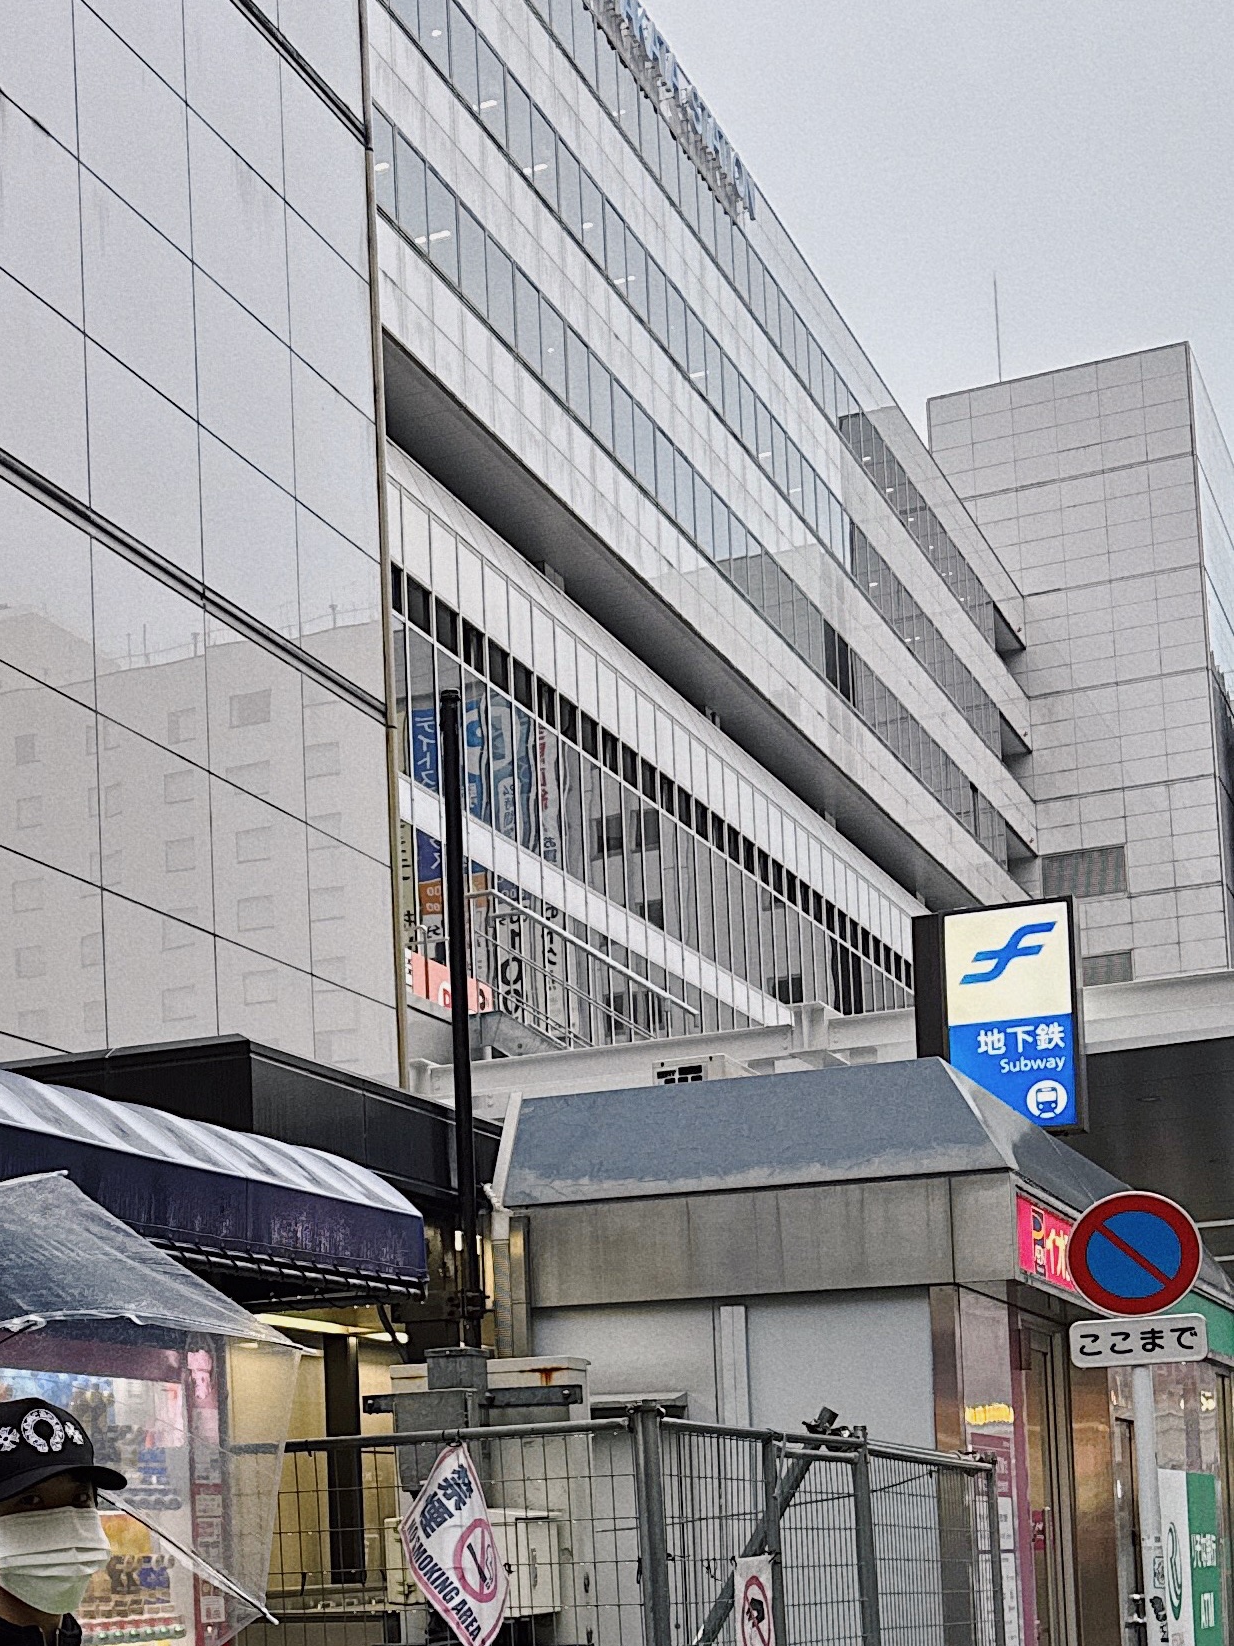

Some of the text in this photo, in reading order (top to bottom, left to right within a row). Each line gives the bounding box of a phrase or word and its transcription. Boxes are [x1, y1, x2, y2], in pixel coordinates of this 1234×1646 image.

[977, 1022, 1066, 1056] 地下鉄
[999, 1055, 1066, 1074] Subway
[1079, 1325, 1198, 1356] ここまで
[420, 1463, 474, 1539] 禁煙
[451, 1594, 483, 1643] AREA
